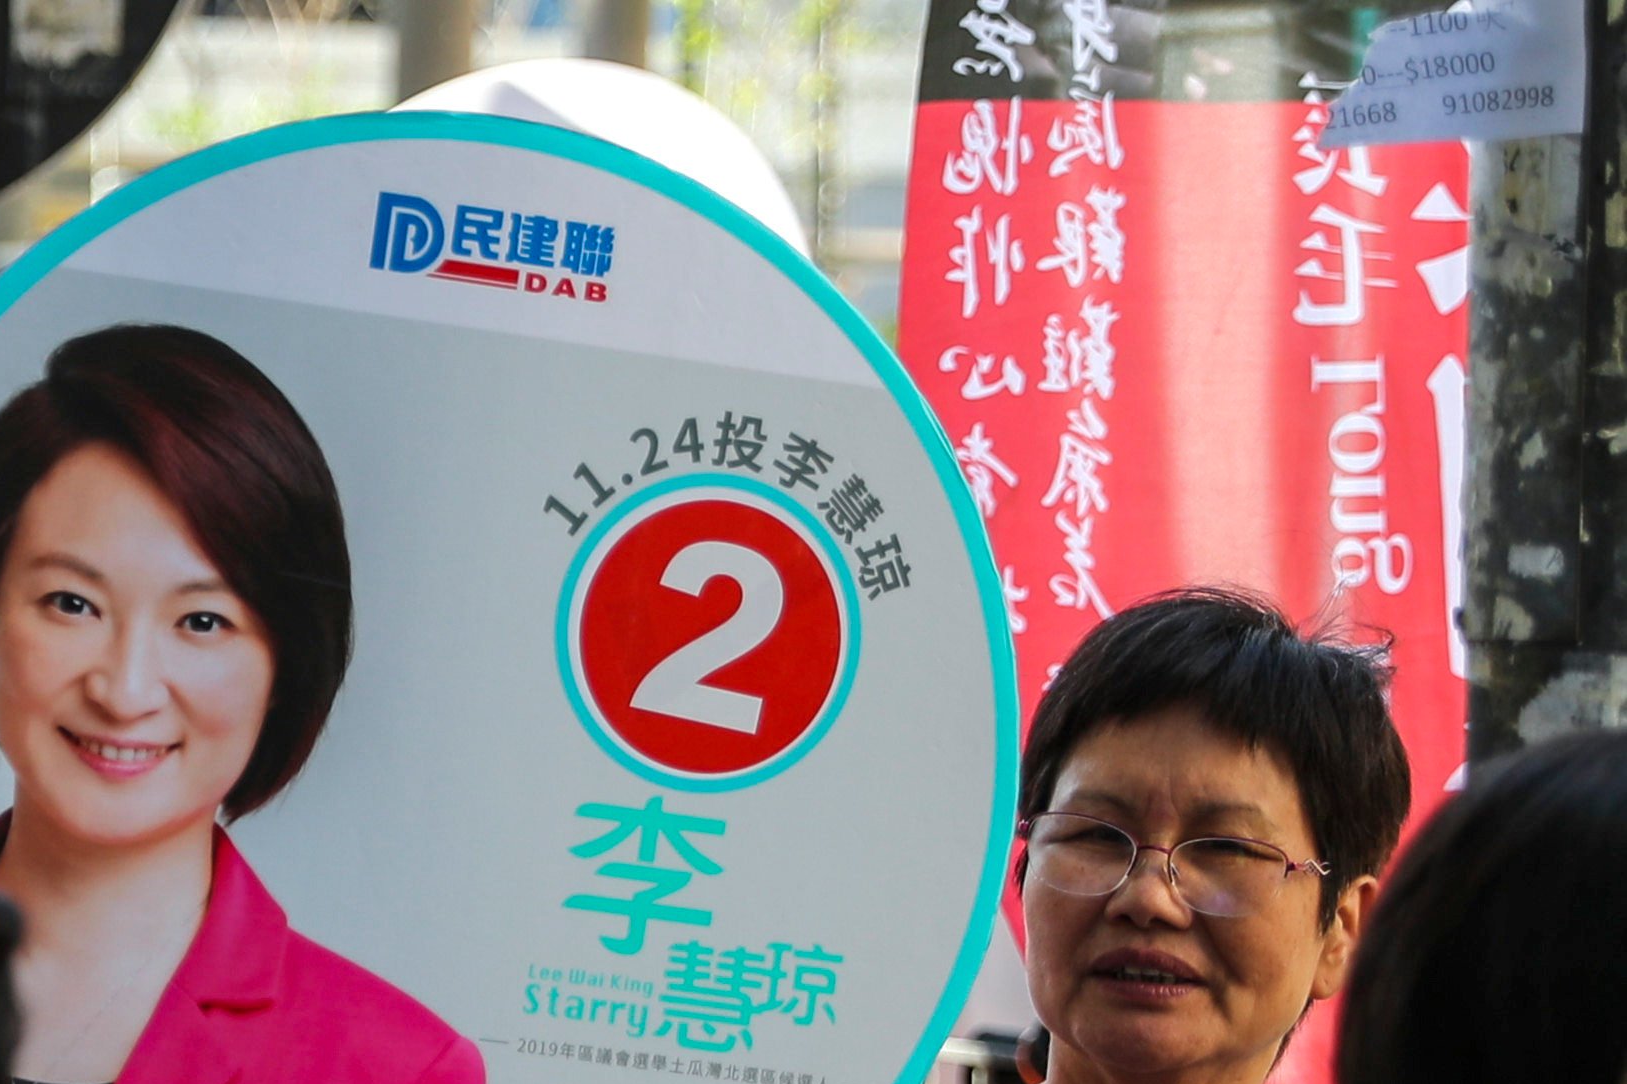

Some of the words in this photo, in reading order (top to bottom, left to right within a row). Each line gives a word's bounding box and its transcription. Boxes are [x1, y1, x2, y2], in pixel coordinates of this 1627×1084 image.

[1442, 86, 1555, 116] 91082998
[451, 204, 615, 278] 民建聯
[524, 272, 608, 303] DAB
[630, 540, 784, 735] 2
[528, 963, 563, 982] Lee
[568, 968, 605, 987] Wai
[610, 974, 654, 999] King
[522, 982, 649, 1038] Starry
